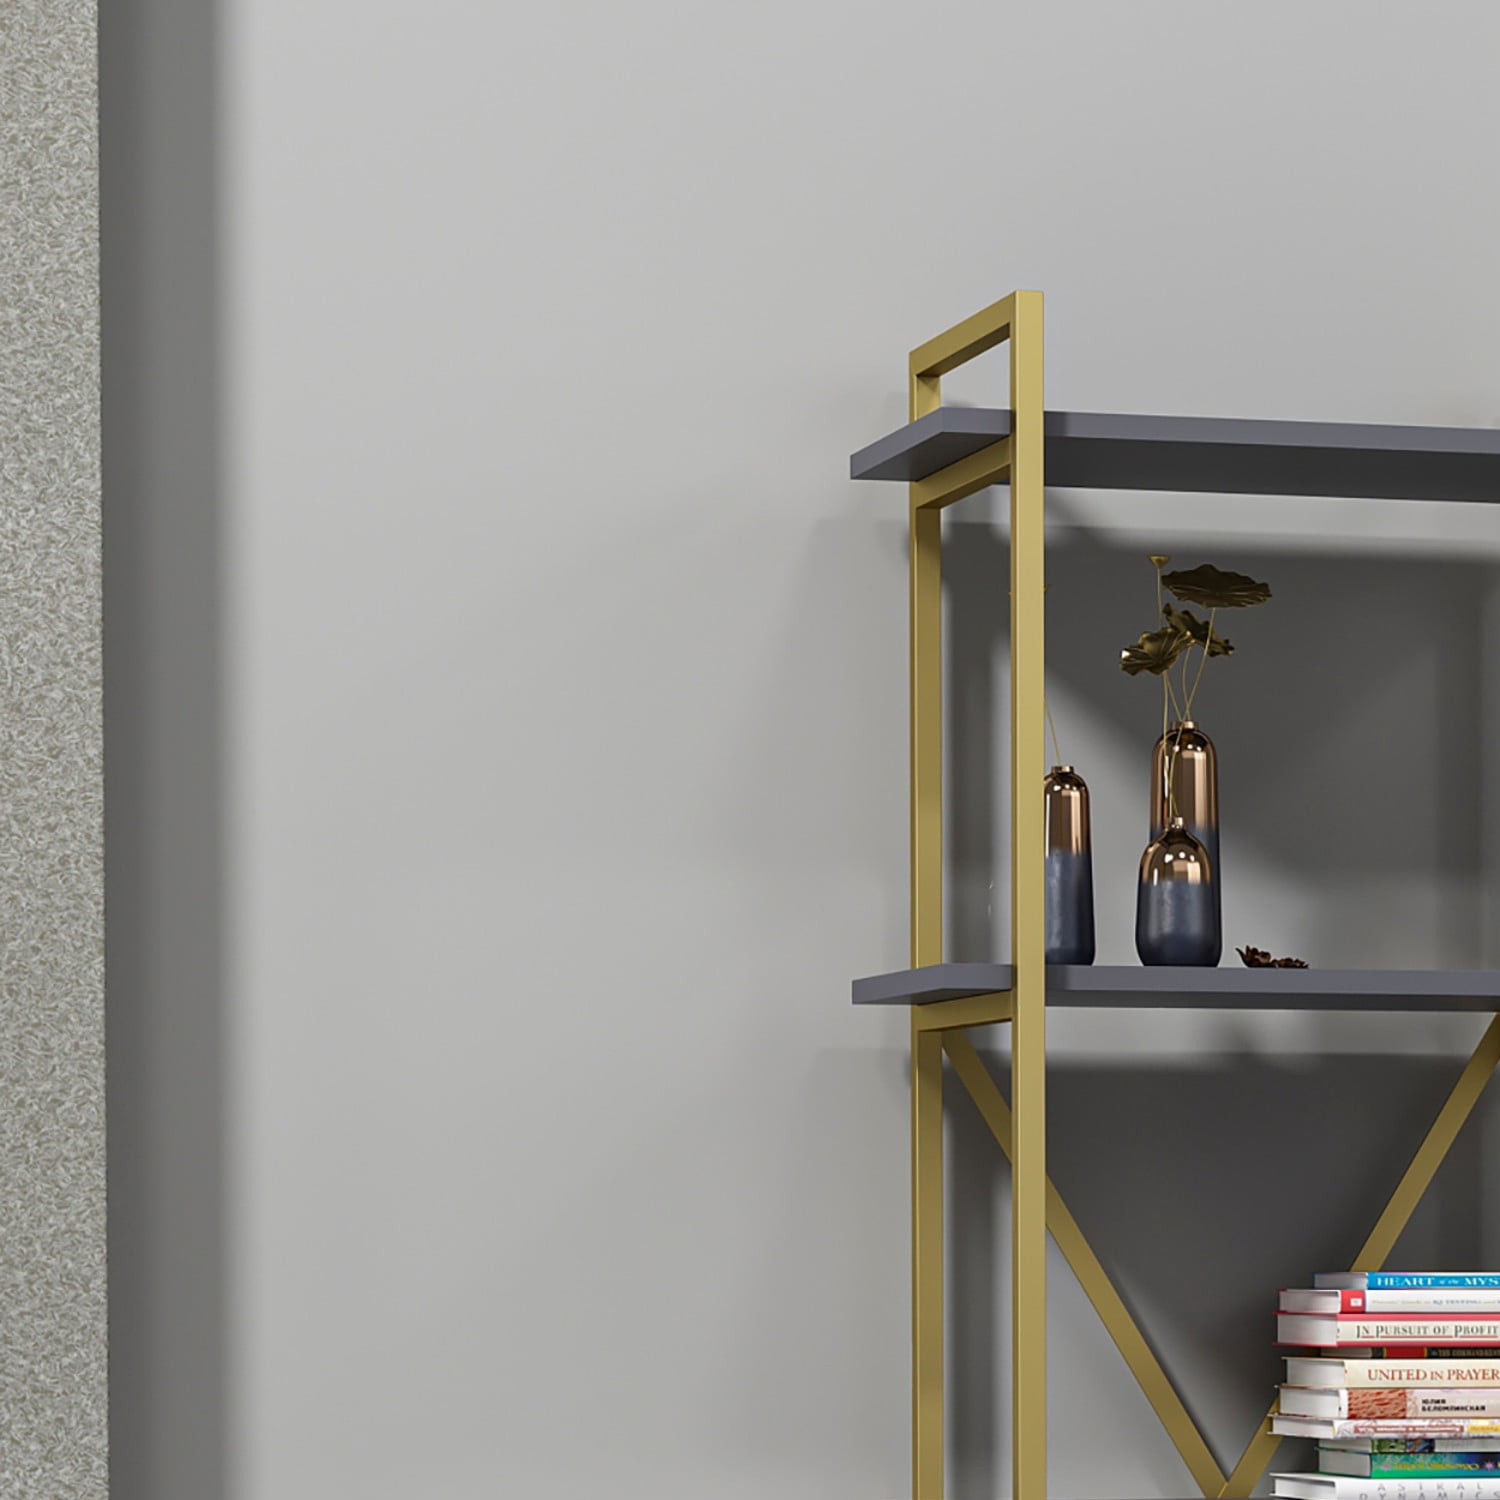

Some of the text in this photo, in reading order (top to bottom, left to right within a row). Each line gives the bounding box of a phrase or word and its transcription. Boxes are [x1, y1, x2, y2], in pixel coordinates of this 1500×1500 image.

[1376, 1277, 1435, 1286] HEART
[1375, 1325, 1429, 1338] PURSUIT
[1433, 1326, 1449, 1335] OF
[1454, 1325, 1499, 1338] PROFIT
[1367, 1368, 1500, 1381] UNITED IN PRAYER
